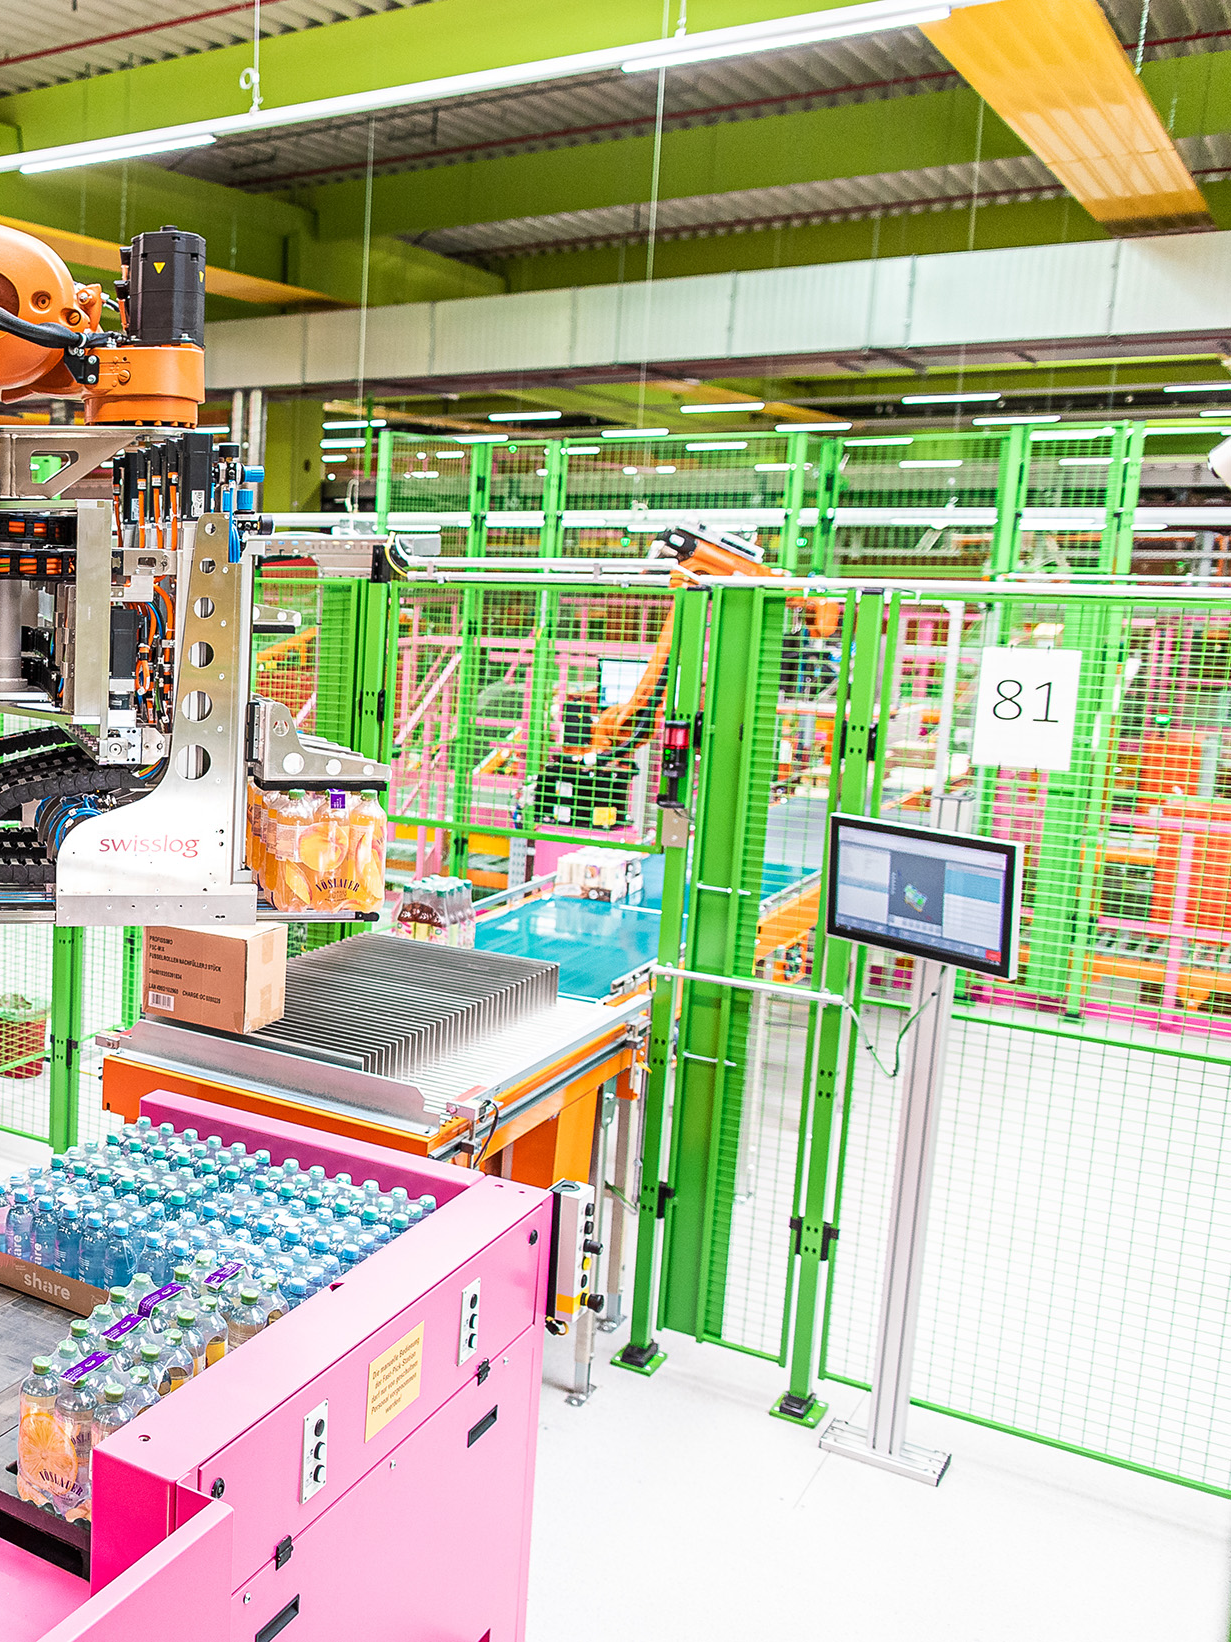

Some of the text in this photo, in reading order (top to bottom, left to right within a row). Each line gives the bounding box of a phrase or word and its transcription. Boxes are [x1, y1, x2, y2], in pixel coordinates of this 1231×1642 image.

[992, 679, 1058, 723] 81
[99, 834, 200, 858] swisslog
[150, 952, 178, 964] FUSSELROLLEN
[208, 964, 222, 972] STÜCK
[23, 1272, 71, 1300] share
[400, 1338, 420, 1358] Bedienung
